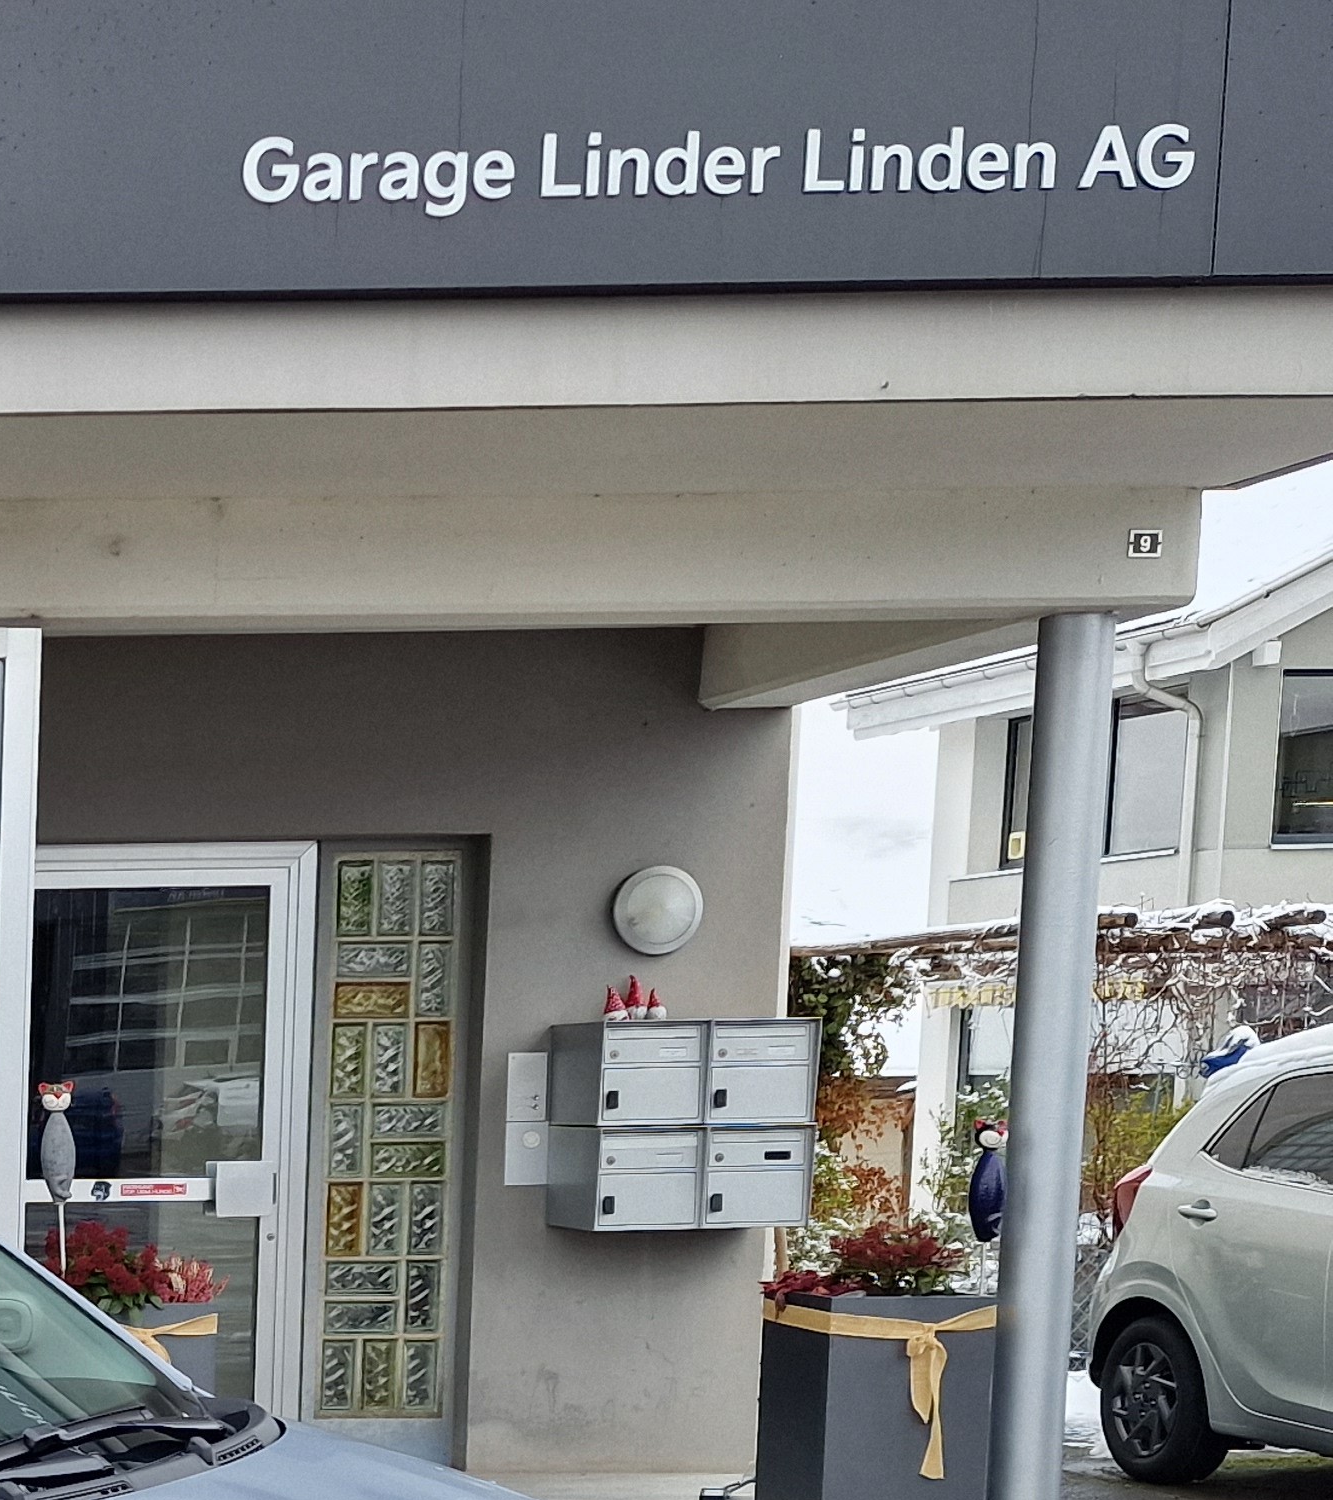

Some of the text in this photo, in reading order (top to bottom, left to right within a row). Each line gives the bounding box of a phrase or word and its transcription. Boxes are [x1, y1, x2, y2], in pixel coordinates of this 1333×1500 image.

[242, 123, 1196, 217] Garage Linder Linden AG
[1139, 535, 1151, 553] 9
